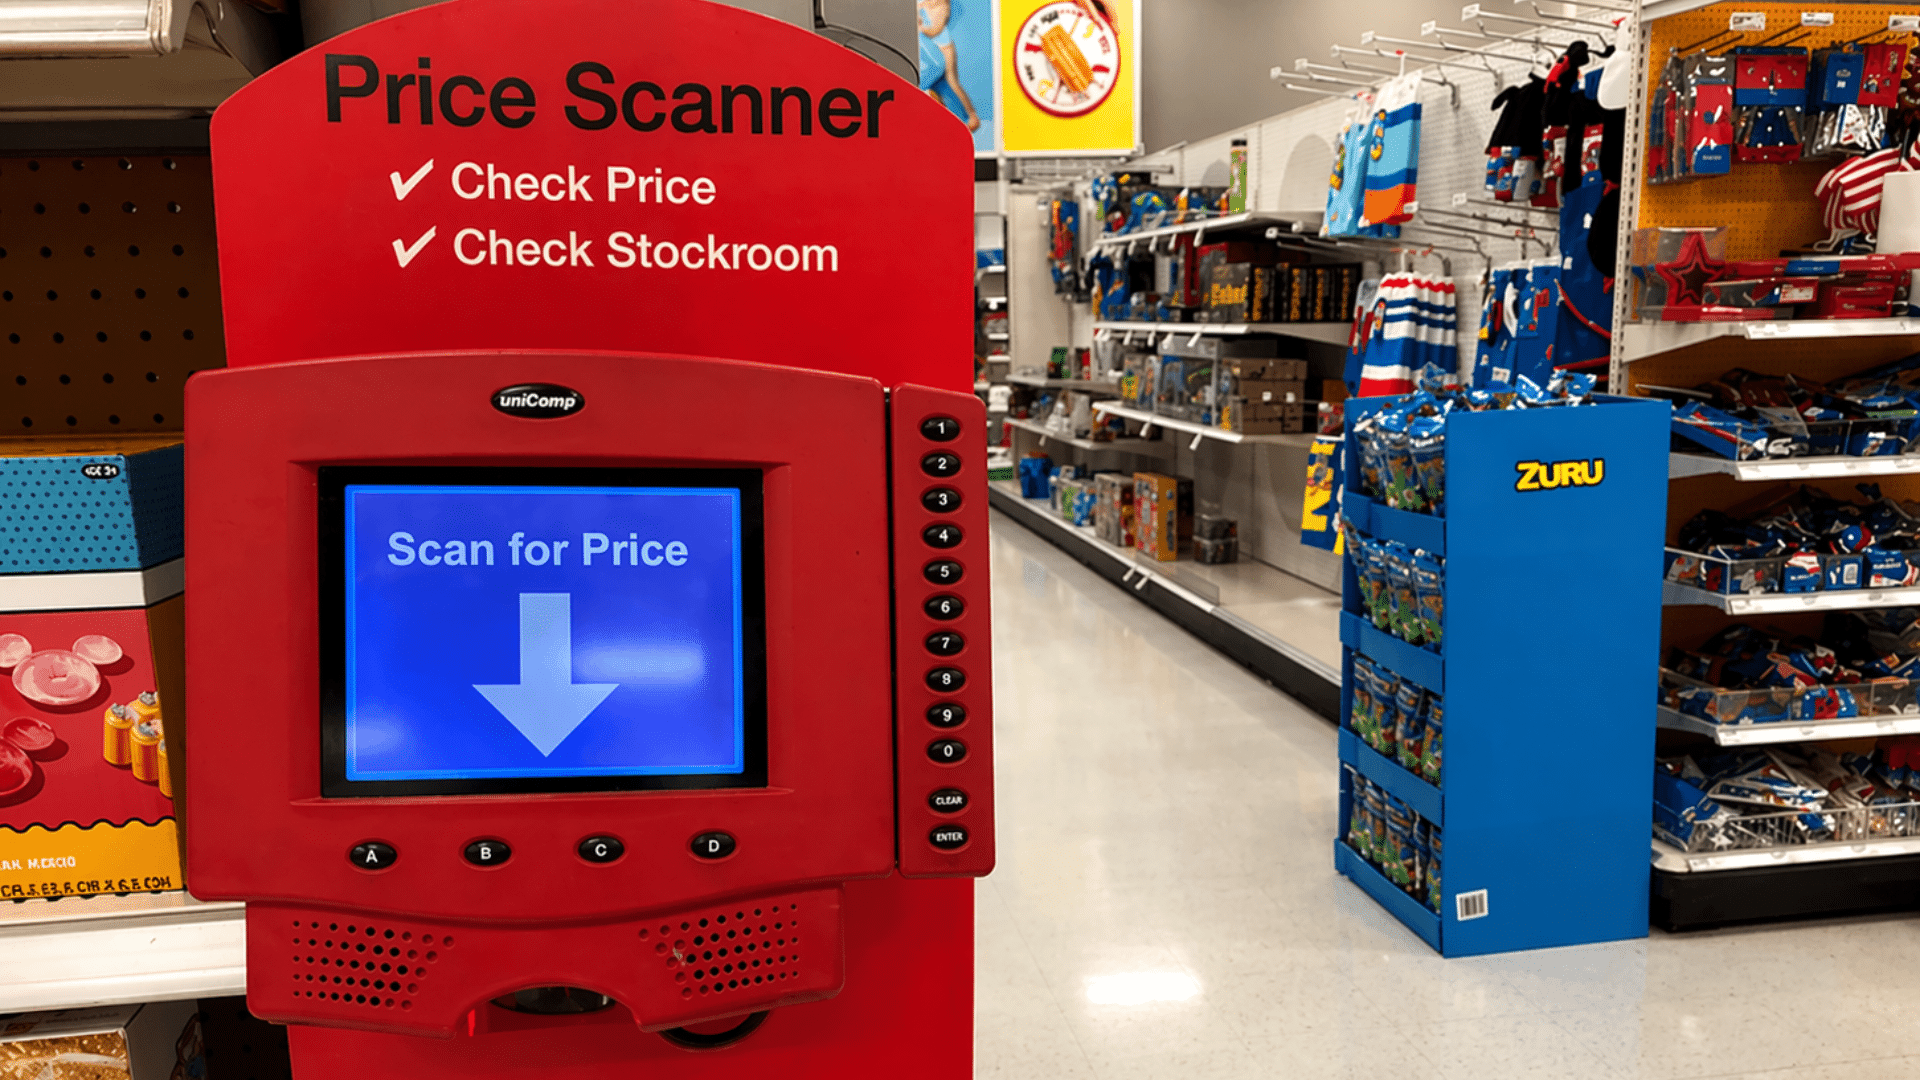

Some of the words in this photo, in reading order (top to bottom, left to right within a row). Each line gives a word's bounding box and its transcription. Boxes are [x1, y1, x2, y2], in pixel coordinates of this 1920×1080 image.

[325, 53, 536, 129] Price
[564, 61, 895, 139] Scanner
[451, 161, 594, 202] Check
[607, 166, 717, 205] Price
[453, 227, 594, 267] Check
[607, 231, 838, 272] Stockroom
[499, 392, 577, 411] uniComp
[938, 421, 947, 434] 1
[937, 457, 948, 470] 2
[1515, 457, 1604, 492] ZURU
[938, 492, 949, 506] 3
[938, 529, 949, 542] 4
[387, 531, 494, 566] Scan
[507, 531, 570, 566] for
[582, 532, 689, 567] Price
[939, 565, 950, 578] 5
[940, 600, 951, 614] 6
[941, 636, 950, 649] 7
[941, 672, 951, 685] 8
[942, 708, 953, 722] 9
[943, 744, 954, 757] 0
[935, 796, 963, 806] CLEAR
[936, 831, 963, 842] ENTER
[480, 846, 492, 860] B
[594, 842, 607, 857] C
[708, 839, 720, 853] D
[365, 848, 379, 864] A
